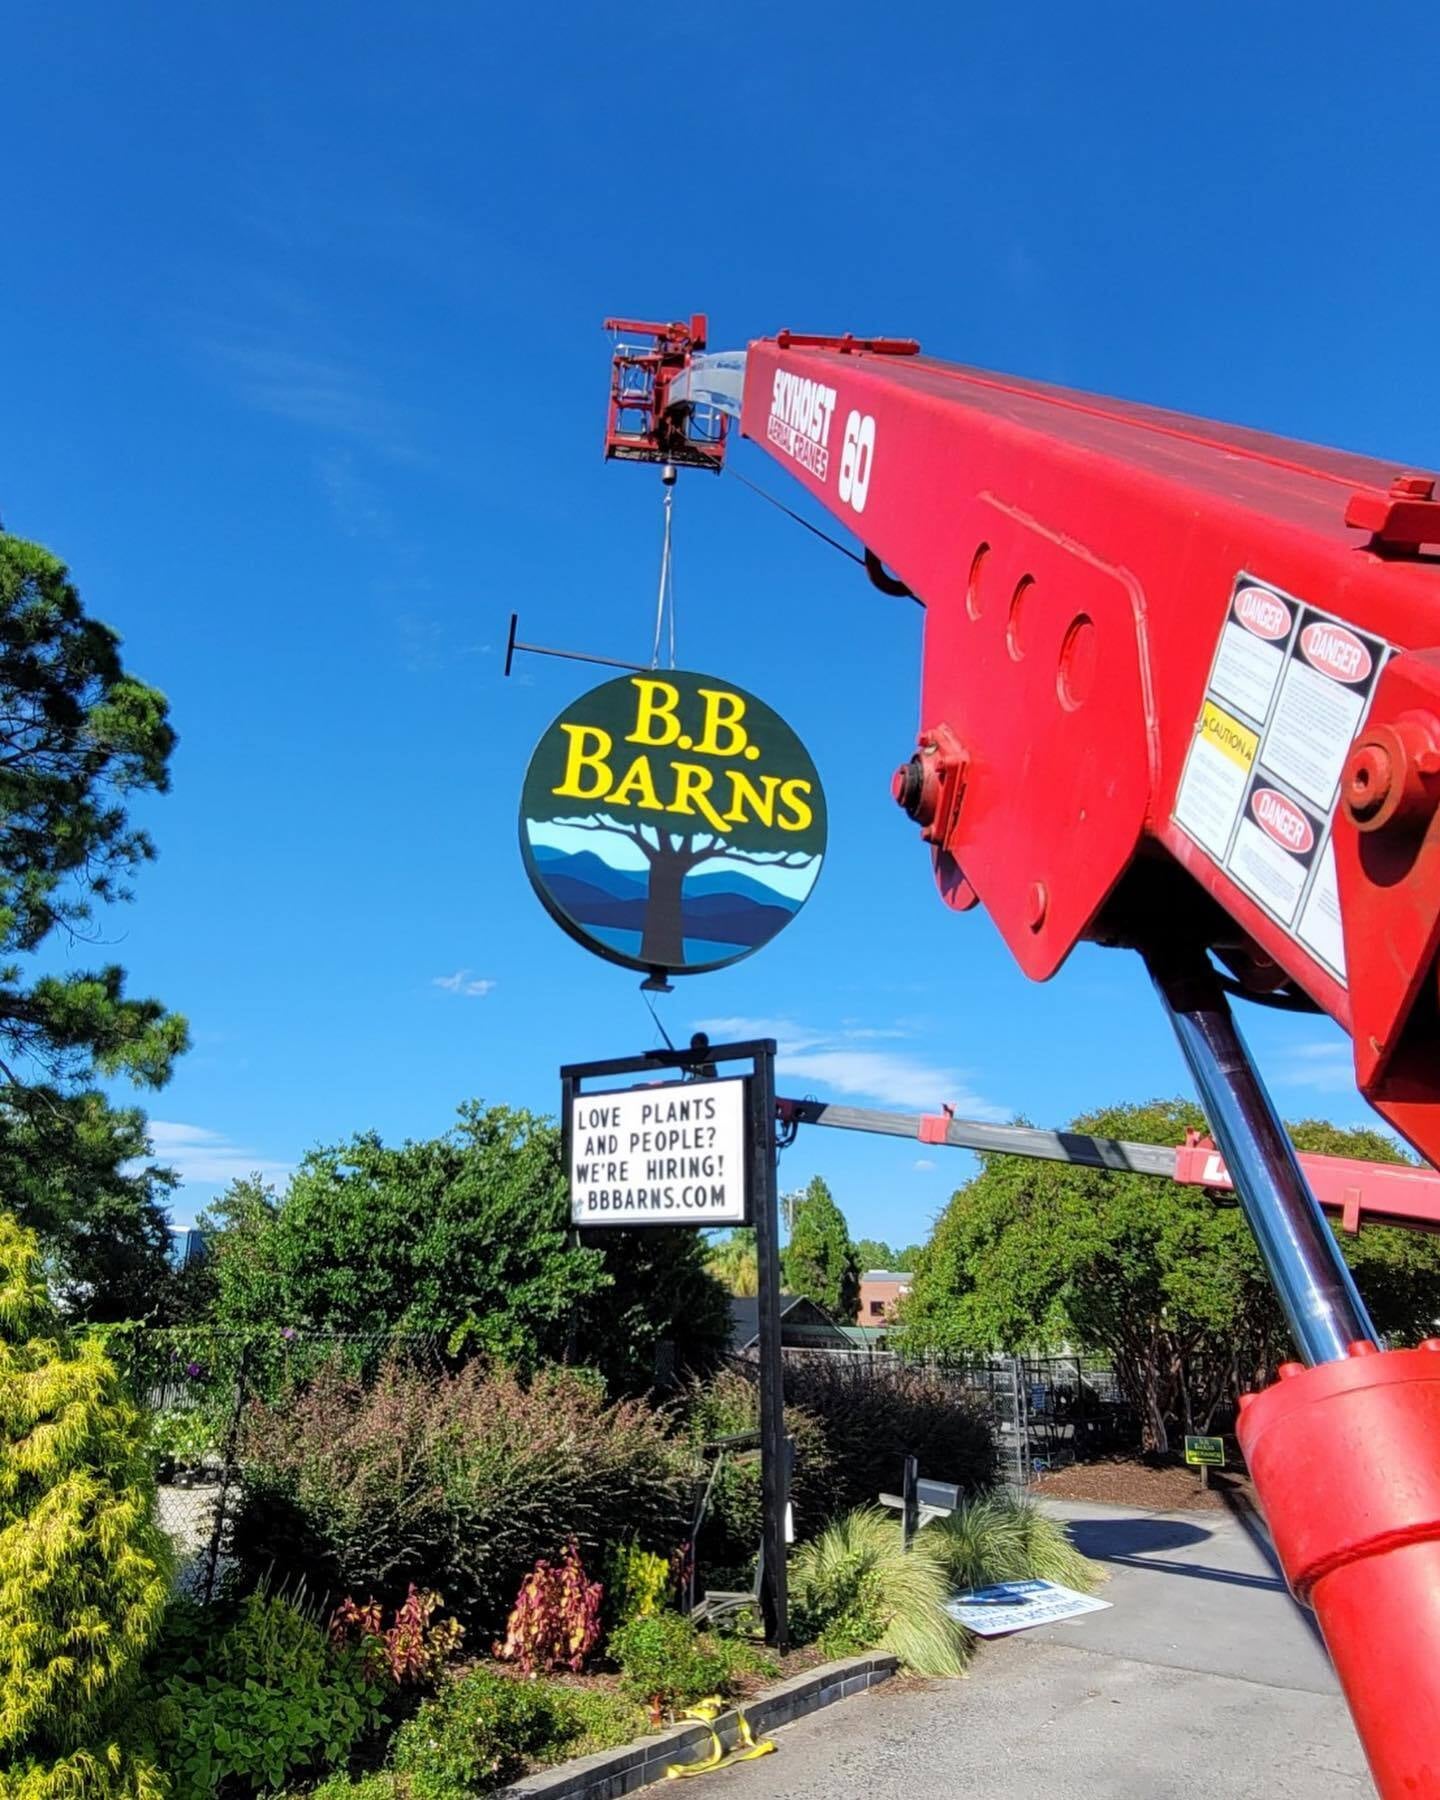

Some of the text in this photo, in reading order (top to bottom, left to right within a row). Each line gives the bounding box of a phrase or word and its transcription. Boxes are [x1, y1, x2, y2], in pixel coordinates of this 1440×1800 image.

[771, 368, 837, 447] SKYHOIST
[838, 410, 876, 513] 60
[1240, 593, 1285, 634] DANGER
[1308, 628, 1362, 676] DANGER
[625, 678, 760, 760] B.B.
[1208, 717, 1247, 756] CAUTION
[552, 723, 812, 832] BARNS
[1258, 793, 1305, 847] DANGER
[579, 1097, 716, 1130] LOVE PLANTS
[584, 1127, 716, 1156] AND PEOPLE?
[576, 1155, 724, 1184] WE'RE HIRING!
[588, 1185, 725, 1210] BBBARNS.COM
